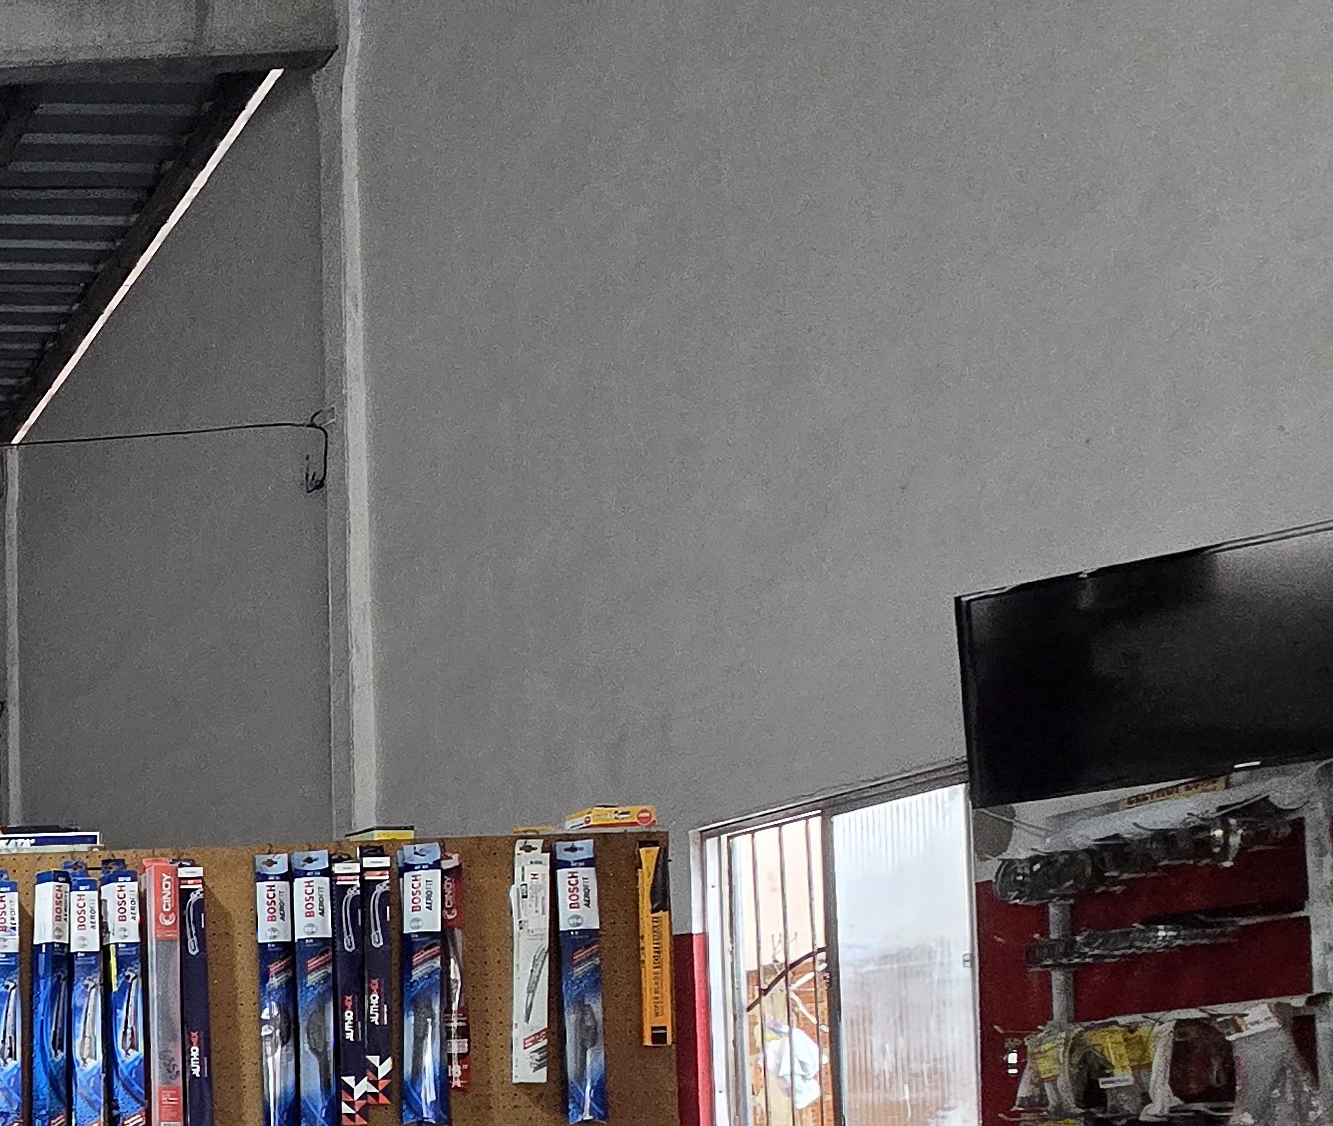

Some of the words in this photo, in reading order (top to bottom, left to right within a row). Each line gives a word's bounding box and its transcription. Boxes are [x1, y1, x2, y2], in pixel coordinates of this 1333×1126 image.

[54, 884, 63, 922] BOSCH
[118, 884, 126, 922] BOSCH
[266, 883, 276, 922] BOSCH
[304, 879, 315, 918] BOSCH
[411, 874, 422, 913] BOSCH
[569, 871, 579, 910] BOSCH
[77, 893, 86, 931] BOSCH
